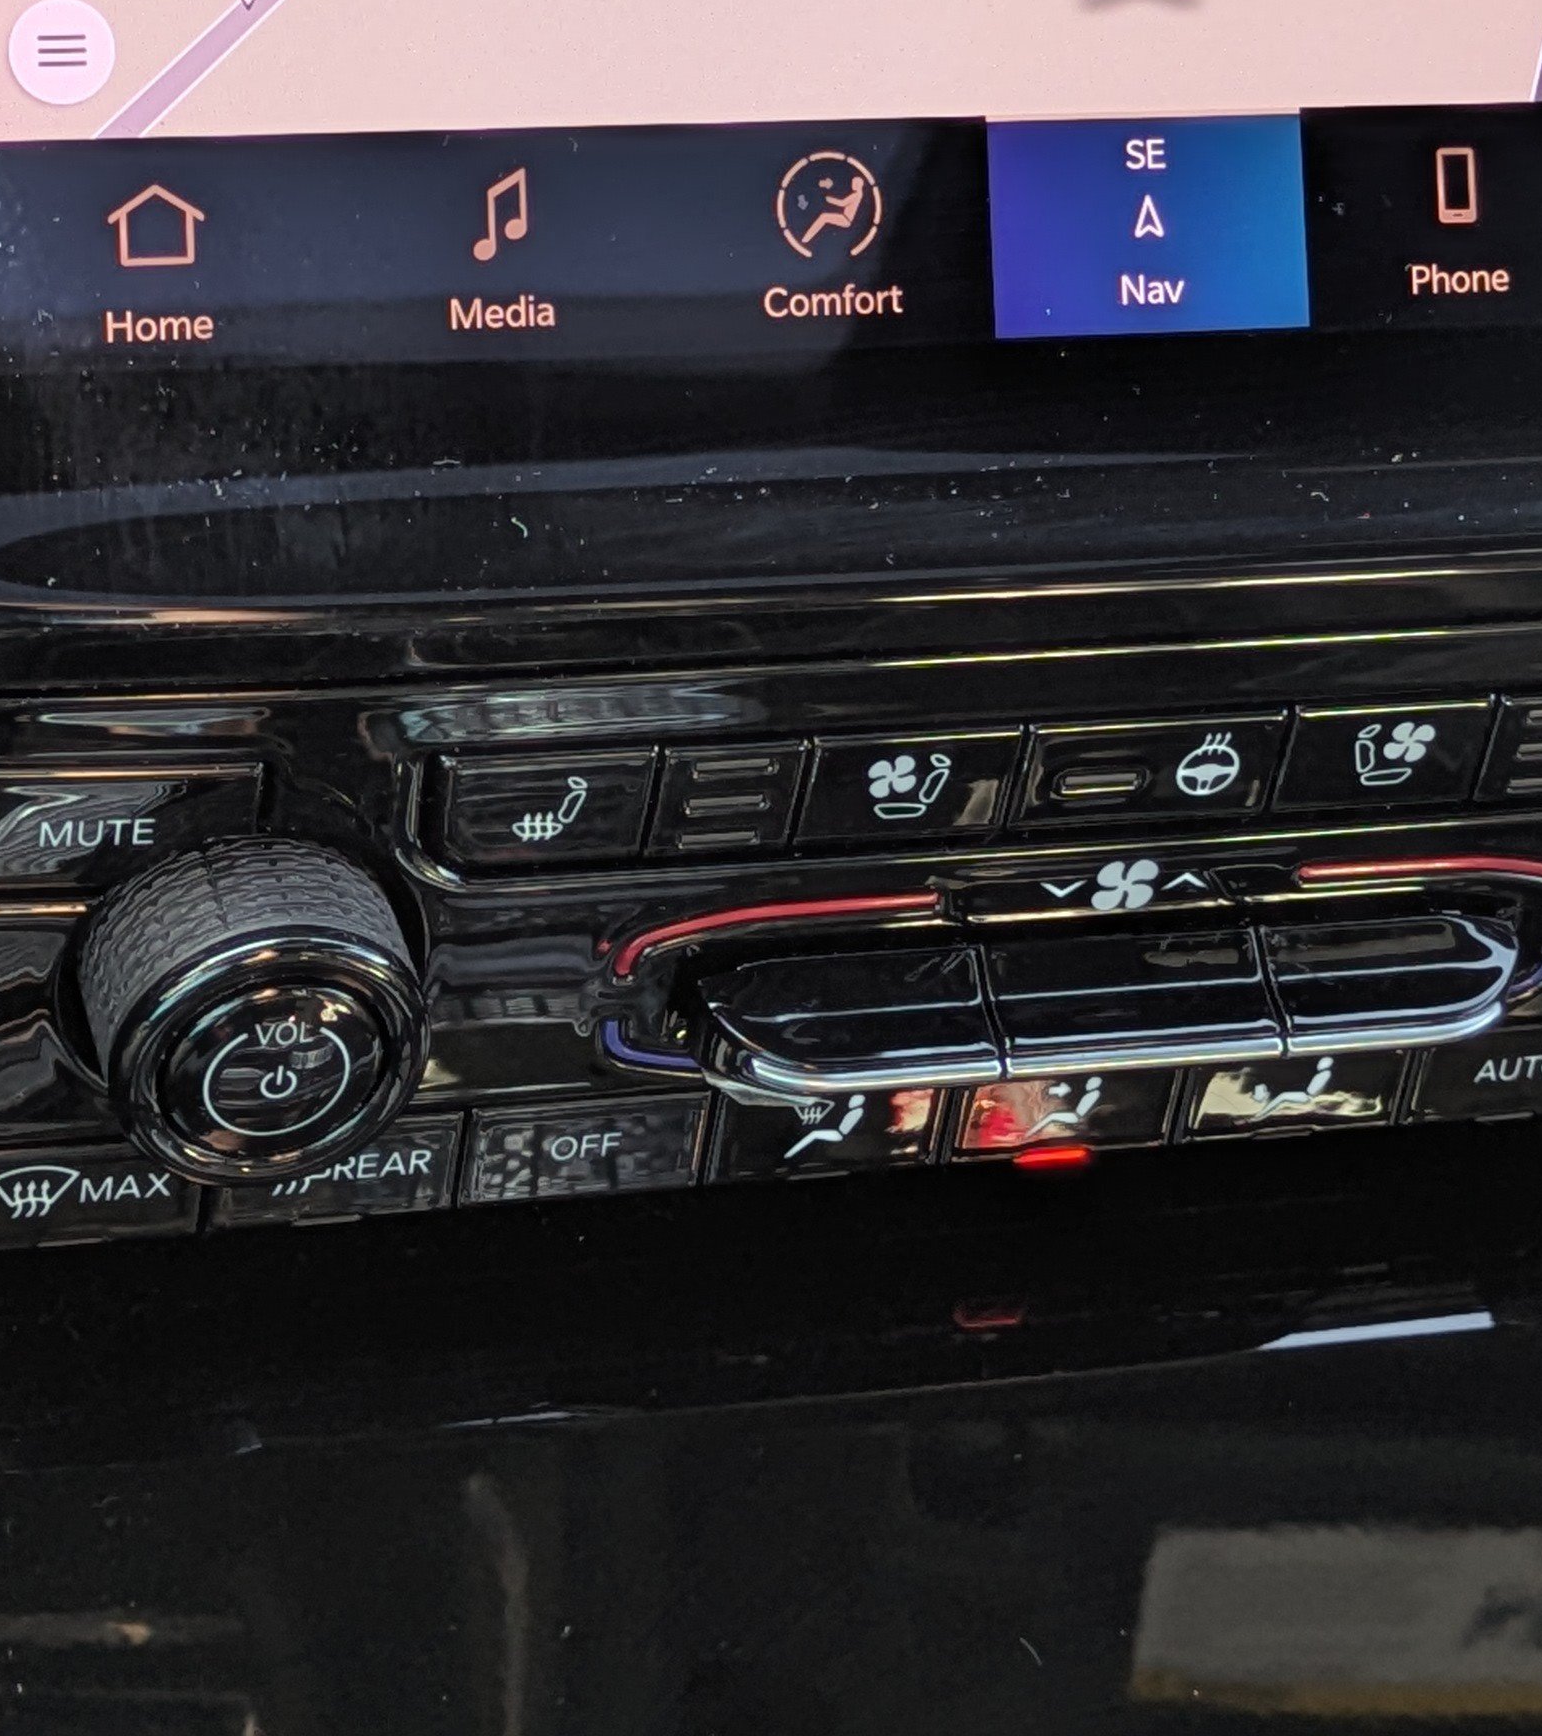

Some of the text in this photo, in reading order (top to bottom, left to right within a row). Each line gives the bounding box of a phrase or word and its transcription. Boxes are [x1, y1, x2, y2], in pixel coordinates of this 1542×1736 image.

[1125, 139, 1167, 171] SE
[1119, 273, 1185, 307] Nav
[1409, 262, 1510, 298] Phone
[449, 297, 556, 332] Media
[763, 284, 903, 320] Comfort
[105, 310, 215, 346] Home
[38, 818, 156, 848] MUTE
[255, 1021, 314, 1047] VOL
[549, 1132, 623, 1161] OFF
[332, 1150, 432, 1182] REAR
[78, 1173, 171, 1204] MAX
